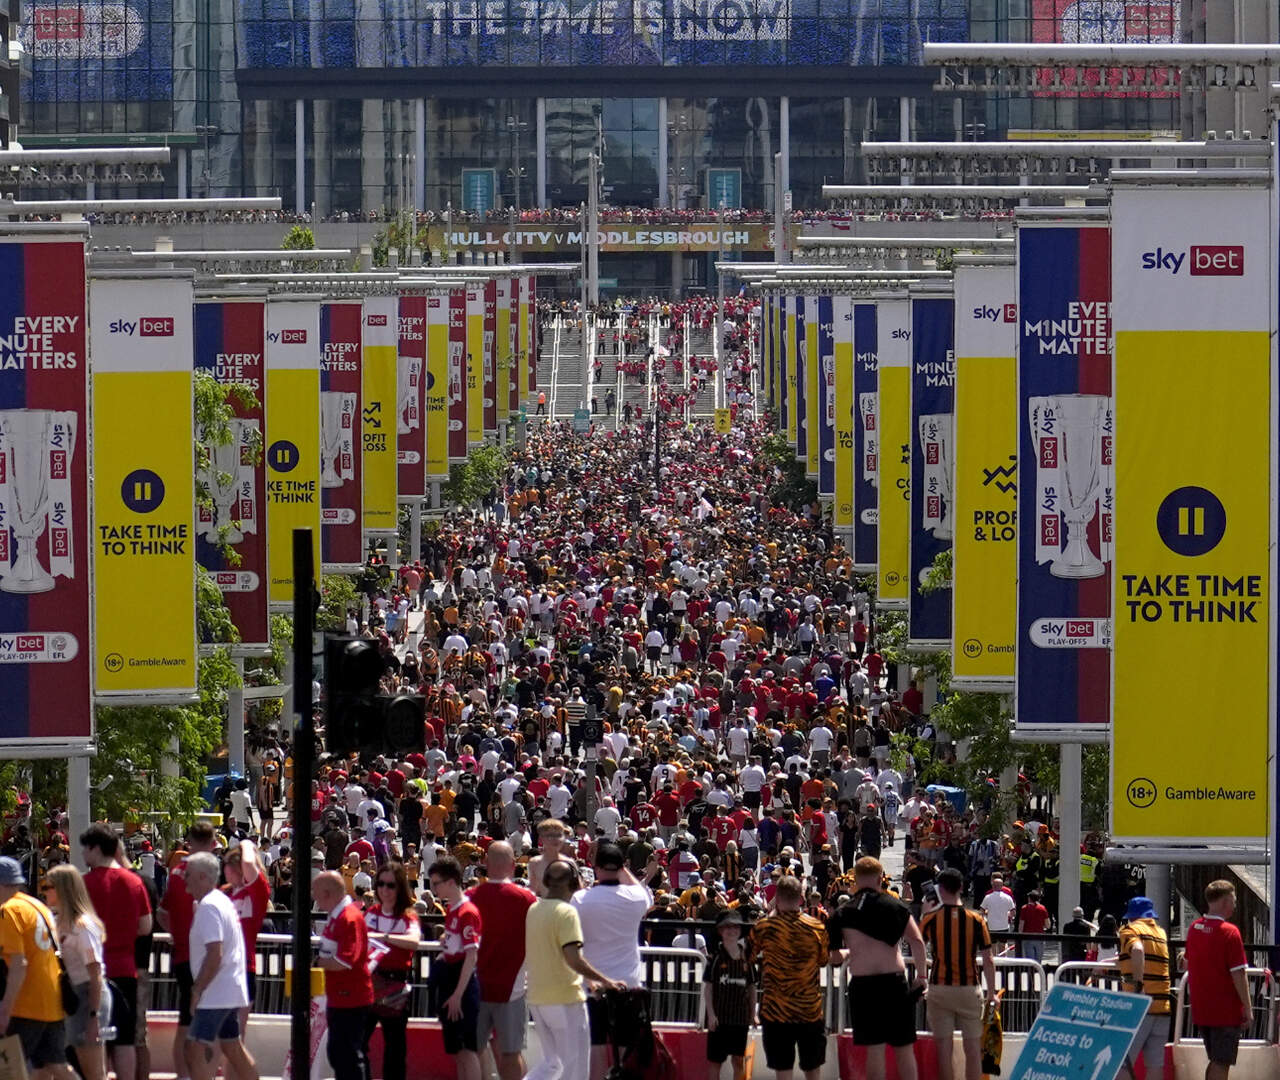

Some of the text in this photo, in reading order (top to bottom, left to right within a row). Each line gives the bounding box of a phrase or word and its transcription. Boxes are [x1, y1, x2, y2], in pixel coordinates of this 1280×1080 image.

[426, 1, 506, 35] THE
[520, 0, 619, 35] TIME
[633, 0, 665, 34] IS
[444, 231, 500, 245] HULL
[502, 231, 552, 244] CITY
[1142, 247, 1239, 274] sky bet
[973, 305, 1001, 321] sky
[14, 316, 79, 334] EVERY
[109, 319, 171, 336] sky bet
[284, 330, 305, 341] bet
[892, 328, 911, 340] sky
[324, 343, 359, 352] EVERY
[216, 353, 261, 366] EVERY
[1041, 408, 1057, 465] sky bet
[285, 481, 316, 491] TIME
[273, 493, 314, 503] THINK
[1042, 486, 1057, 543] sky bet
[52, 502, 67, 554] sky bet
[99, 524, 187, 540] TAKE TIME
[974, 527, 1015, 541] & LO
[102, 541, 186, 555] TO THINK
[1122, 575, 1261, 597] TAKE TIME
[1126, 600, 1258, 623] TO THINK
[1041, 622, 1091, 640] sky bet
[19, 638, 42, 649] bet
[1048, 638, 1088, 646] PLAY-OFFS
[128, 657, 186, 667] GambleAware
[662, 768, 669, 779] 9
[1165, 786, 1256, 800] GambleAware
[637, 810, 650, 822] 14
[721, 823, 728, 834] 3
[1062, 990, 1133, 1010] Wembley Stadium
[1071, 1006, 1113, 1023] Event Day
[1033, 1026, 1094, 1049] Access to
[1035, 1048, 1073, 1067] Brook
